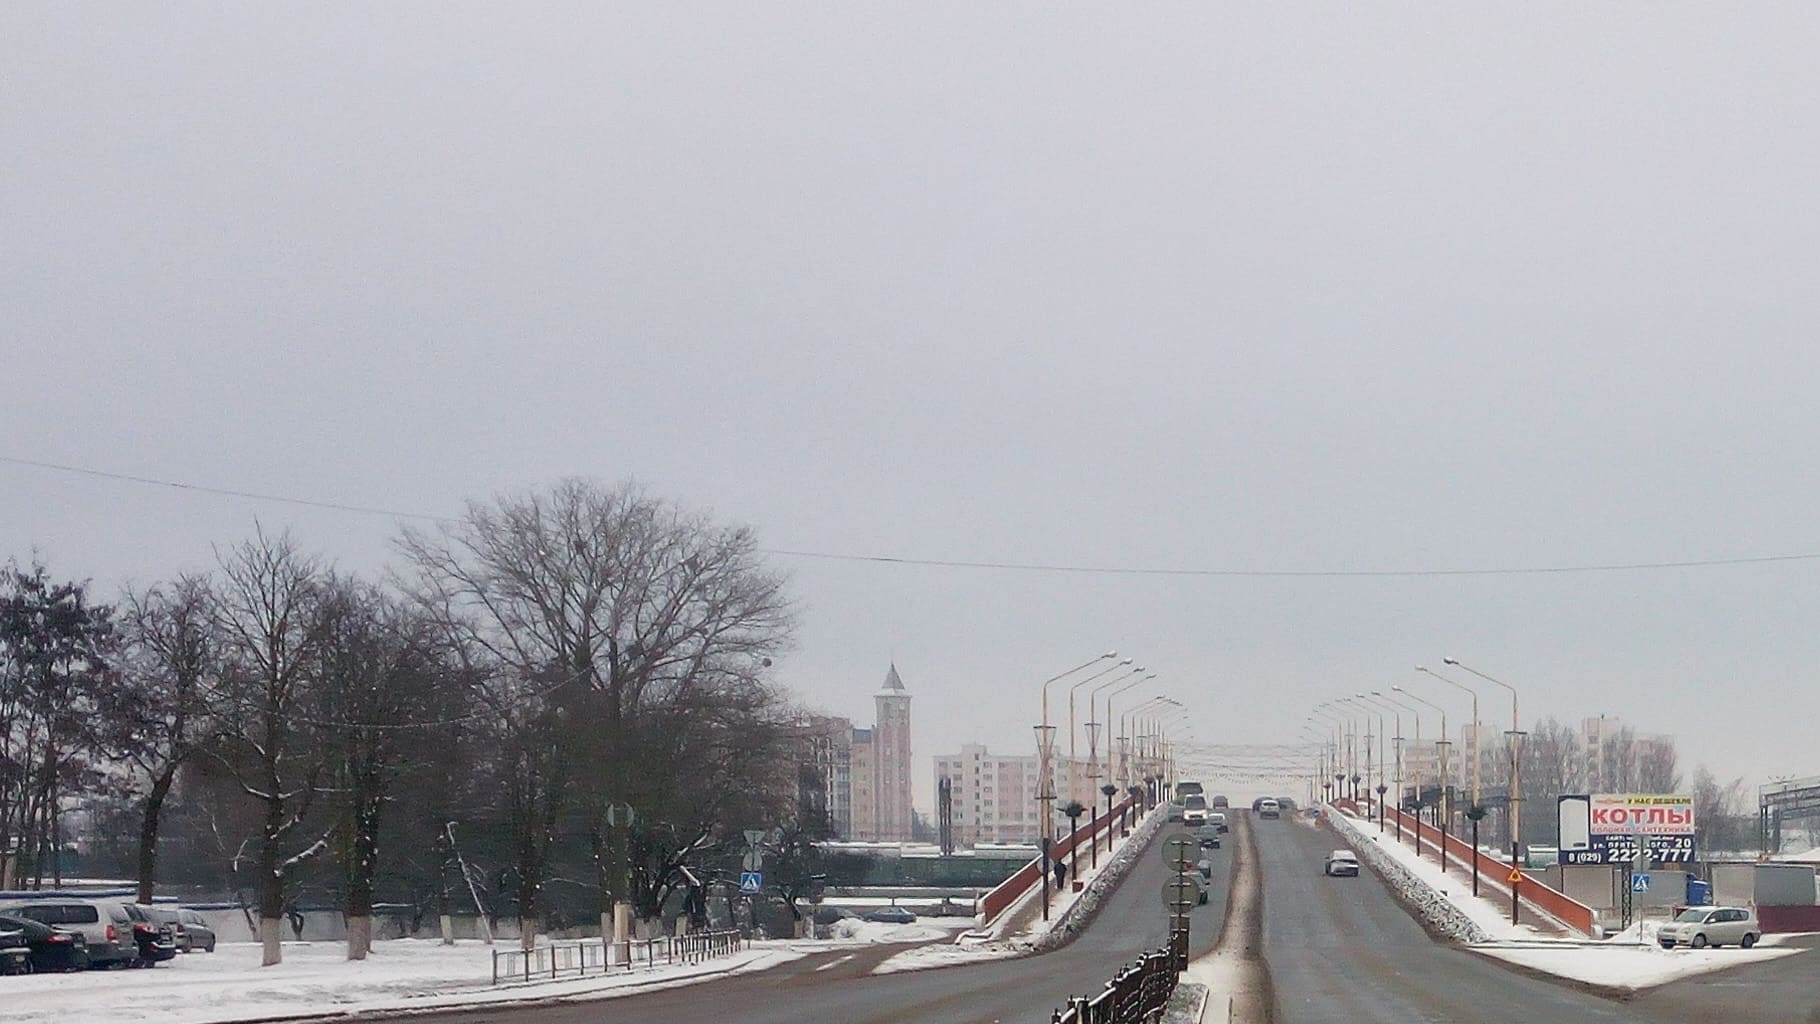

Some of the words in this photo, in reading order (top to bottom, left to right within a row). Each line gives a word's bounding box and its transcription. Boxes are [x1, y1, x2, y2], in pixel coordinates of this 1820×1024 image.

[1592, 808, 1692, 825] КОТЛЫ
[1674, 838, 1692, 848] 20
[1568, 853, 1576, 863] 8
[1577, 852, 1602, 864] (029)
